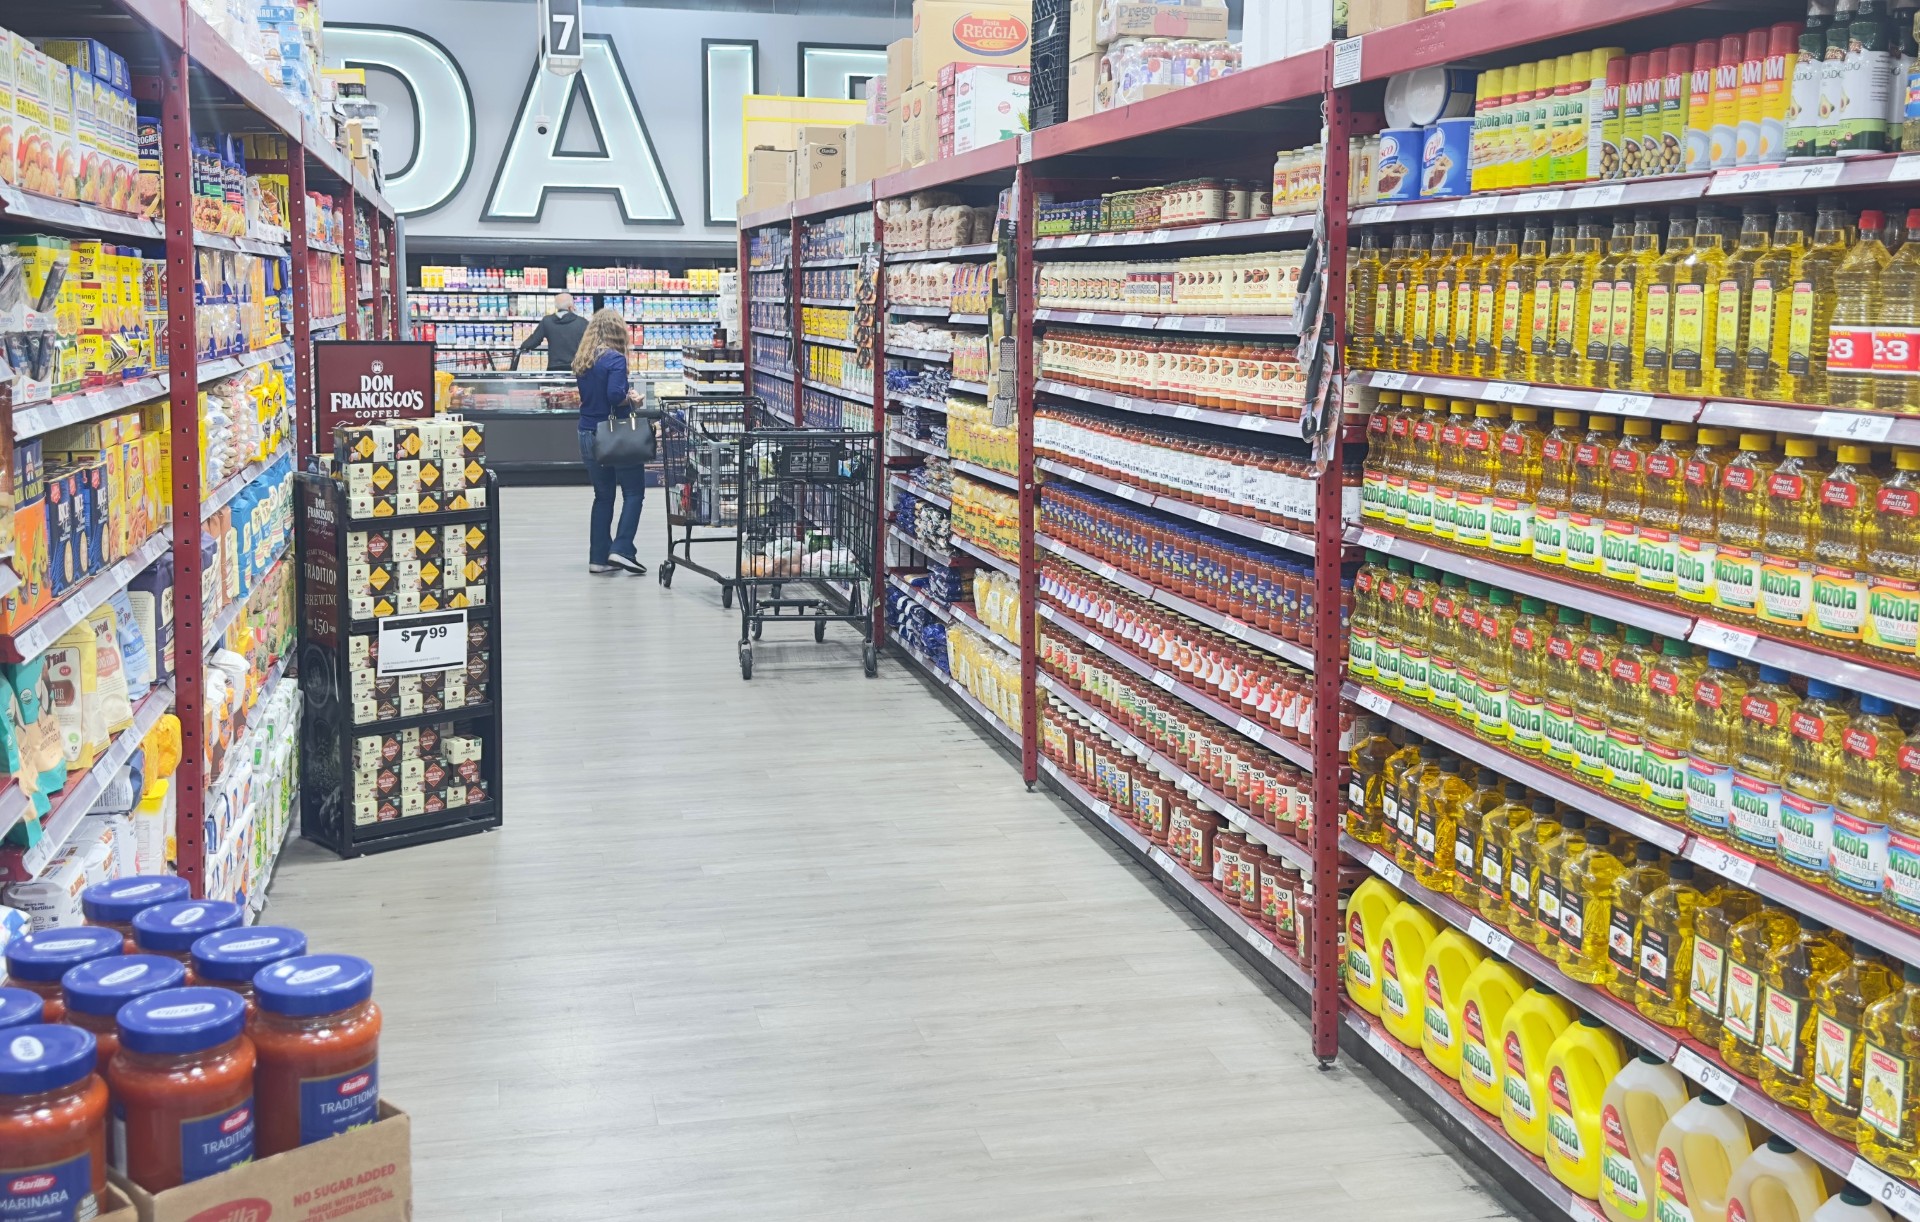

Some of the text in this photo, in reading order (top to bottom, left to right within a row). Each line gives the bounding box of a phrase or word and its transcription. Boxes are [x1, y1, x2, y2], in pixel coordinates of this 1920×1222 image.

[982, 19, 1000, 27] Pasta
[1119, 5, 1158, 21] Prego
[552, 15, 575, 50] 7
[962, 23, 1020, 40] REGGIA
[1717, 66, 1737, 90] AM
[1741, 61, 1762, 85] AM
[1766, 55, 1785, 81] AM
[1644, 79, 1662, 102] AM
[1664, 75, 1681, 98] AM
[1691, 70, 1710, 94] AM
[1604, 85, 1620, 107] AM
[1625, 82, 1643, 105] AM
[1872, 339, 1909, 361] 2-3
[360, 375, 393, 392] DON
[330, 389, 424, 413] FRANCISCO'S
[355, 409, 400, 419] COFFEE
[1726, 475, 1747, 485] Healthy
[1729, 469, 1745, 477] Heart
[1776, 477, 1793, 486] Heart
[1772, 483, 1796, 493] Healthy
[1825, 490, 1849, 501] Healthy
[1829, 484, 1846, 493] Heart
[1887, 492, 1909, 501] Heart
[1407, 494, 1432, 517] azola
[1435, 500, 1456, 523] azola
[1882, 498, 1911, 509] Healthy
[1535, 522, 1561, 547] azola
[1567, 527, 1595, 554] azola
[1678, 556, 1705, 583] azola
[1714, 559, 1753, 587] Mazola
[1760, 569, 1801, 598] Mazola
[1813, 581, 1857, 610] Mazola
[1817, 605, 1833, 616] CORN
[1870, 591, 1919, 623] Mazola
[314, 618, 329, 636] 150
[1896, 621, 1919, 633] PLUS
[1351, 638, 1372, 661] azola
[1746, 704, 1770, 717] Healthy
[1750, 699, 1768, 710] Heart
[1794, 723, 1818, 735] Healthy
[1798, 715, 1815, 726] Heart
[1846, 738, 1870, 751] Healthy
[1850, 731, 1867, 742] Heart
[1732, 789, 1769, 818] Mazola
[1736, 810, 1778, 829] VEGETABLE
[1780, 808, 1815, 838] Mazola
[1833, 828, 1868, 860] Mazola
[1837, 853, 1880, 872] VEGETABLE
[1424, 1007, 1449, 1038] Mazola
[1463, 1042, 1491, 1077] Mazola
[1882, 1056, 1899, 1074] LUCAS
[341, 1076, 369, 1093] Barilla
[1503, 1074, 1531, 1112] Mazola
[224, 1110, 249, 1131] Barilla
[202, 1119, 254, 1155] TRADITION
[1548, 1114, 1578, 1152] Mazola
[13, 1177, 53, 1191] Barilla
[294, 1163, 396, 1206] NO SUGAR ADDED
[1603, 1157, 1638, 1195] Mazola
